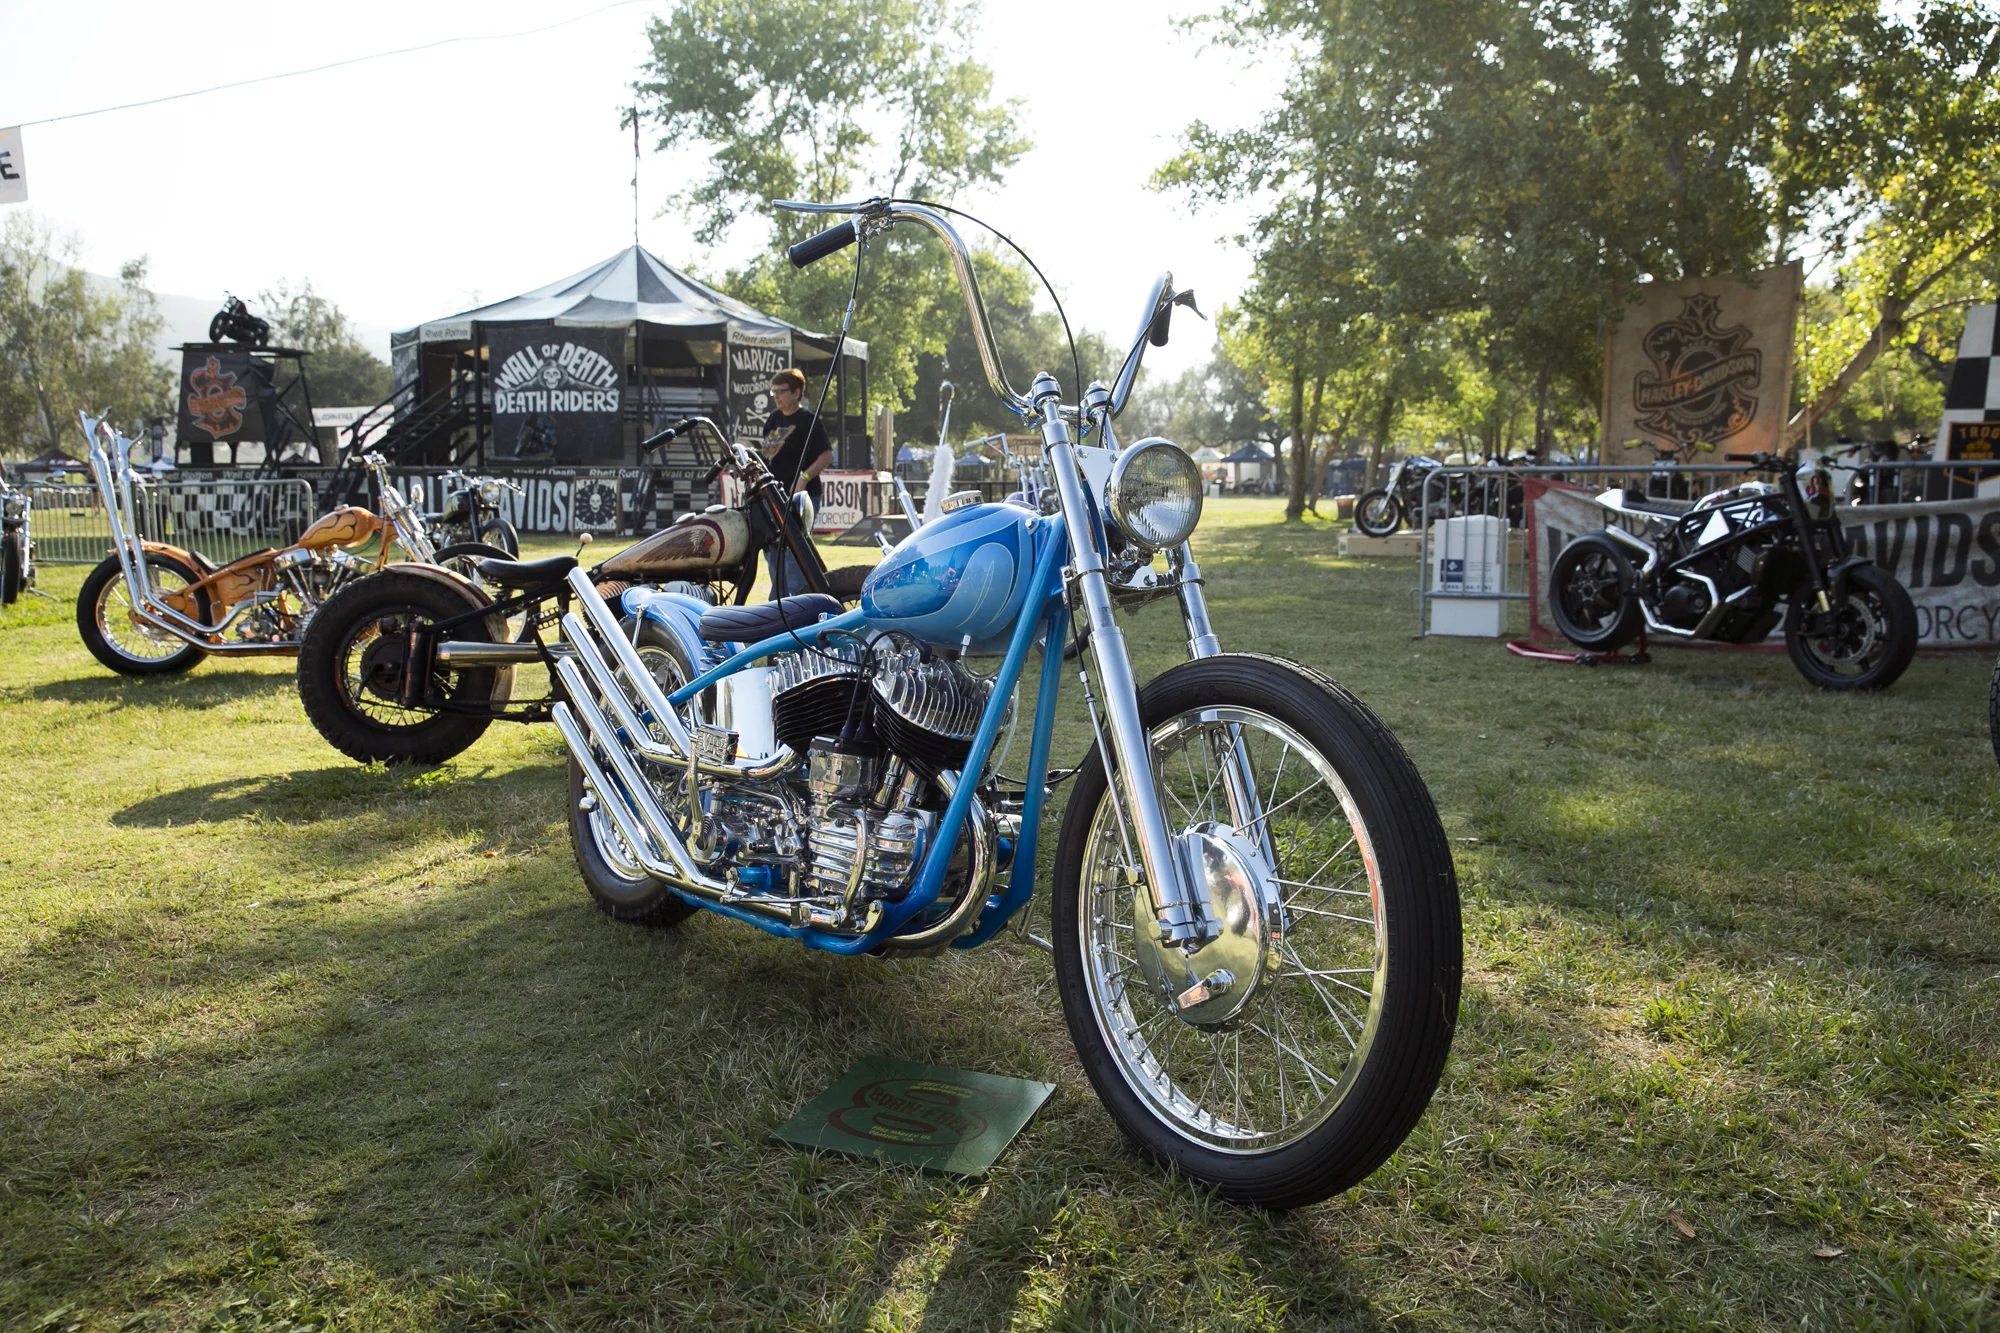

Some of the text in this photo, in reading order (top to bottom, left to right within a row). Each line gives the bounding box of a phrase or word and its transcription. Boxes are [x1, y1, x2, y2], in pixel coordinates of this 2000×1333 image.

[732, 331, 787, 345] Rhett Rotten
[494, 342, 619, 390] WALL OF DEATH
[732, 348, 785, 373] MARVELS
[733, 379, 772, 396] MOTORDR
[1641, 353, 1755, 404] HARLEY-DAVIDSON
[495, 390, 620, 414] DEATH RIDERS
[737, 424, 758, 437] EATH
[589, 468, 616, 478] Rhett
[661, 469, 683, 479] Wall
[684, 469, 694, 479] of
[821, 480, 862, 509] IDSON
[814, 511, 856, 525] TORCYCLE
[1603, 508, 1649, 538] RID
[1846, 511, 2000, 588] AVIDS
[1917, 603, 2000, 640] ORCY
[868, 1085, 980, 1137] BORN-FREE
